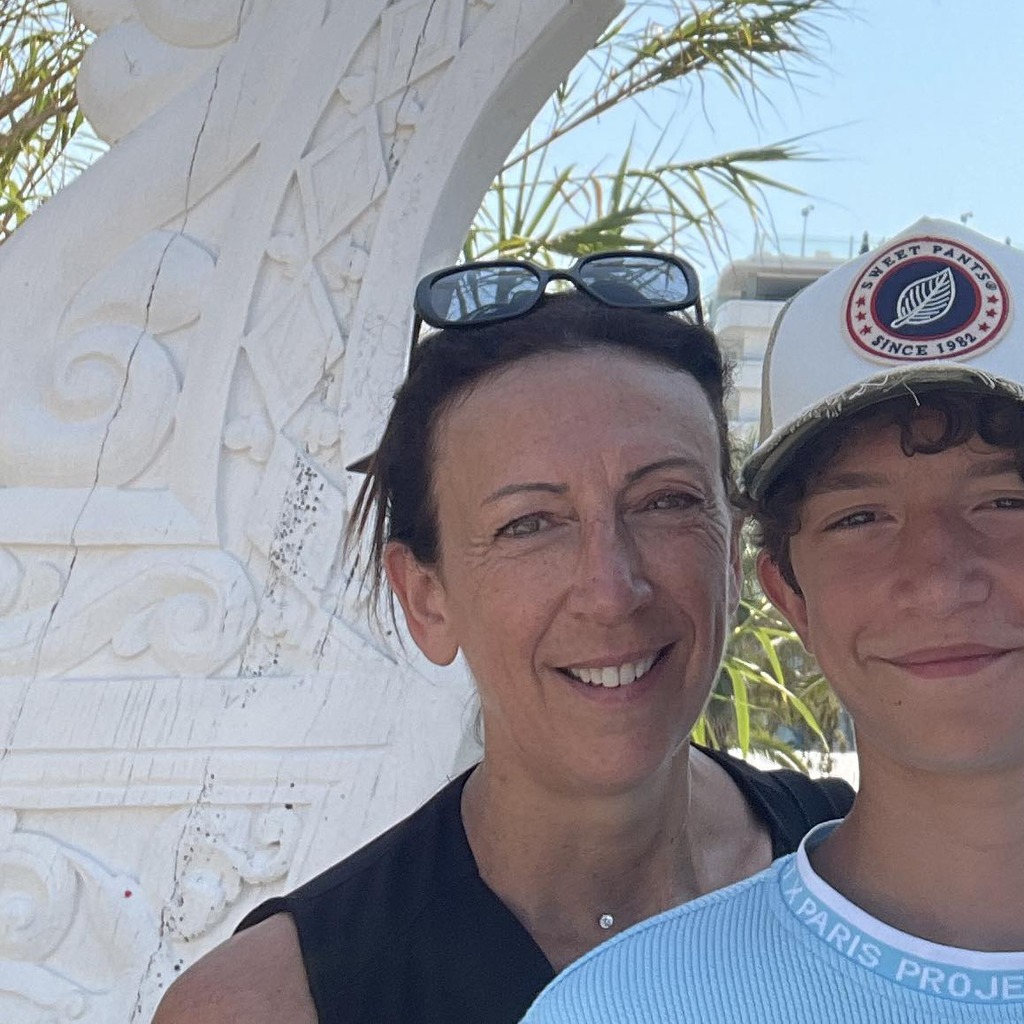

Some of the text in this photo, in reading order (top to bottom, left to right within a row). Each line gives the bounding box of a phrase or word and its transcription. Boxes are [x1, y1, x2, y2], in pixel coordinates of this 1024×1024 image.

[861, 245, 921, 290] SWEET
[871, 332, 977, 357] SINCE 1982
[795, 896, 882, 968] PARIS
